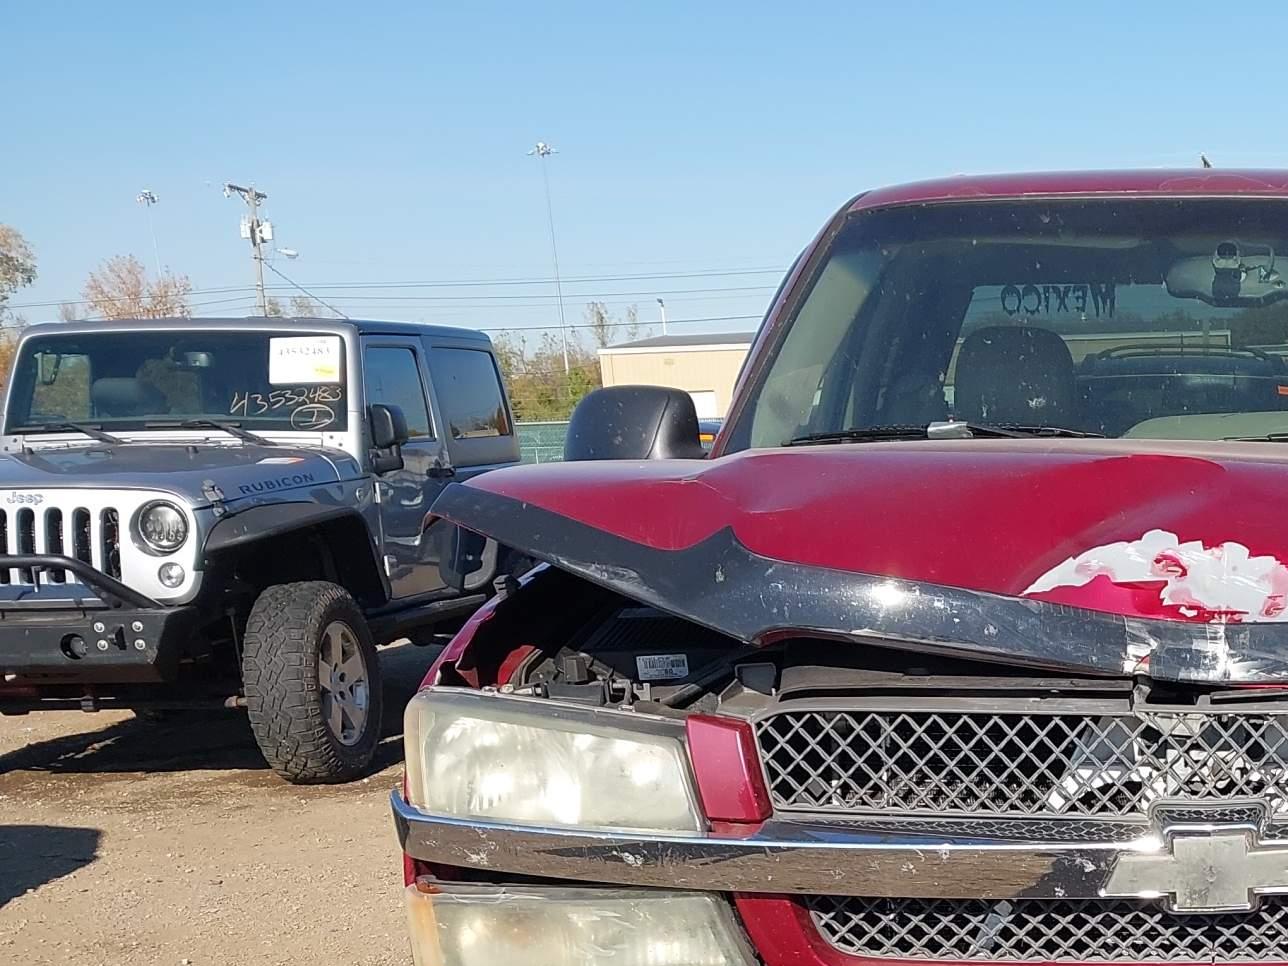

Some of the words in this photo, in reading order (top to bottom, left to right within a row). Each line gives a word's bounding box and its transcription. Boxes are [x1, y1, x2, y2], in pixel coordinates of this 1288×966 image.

[230, 386, 342, 417] 43532483
[238, 473, 315, 494] RUBICON
[6, 491, 44, 506] Jeep
